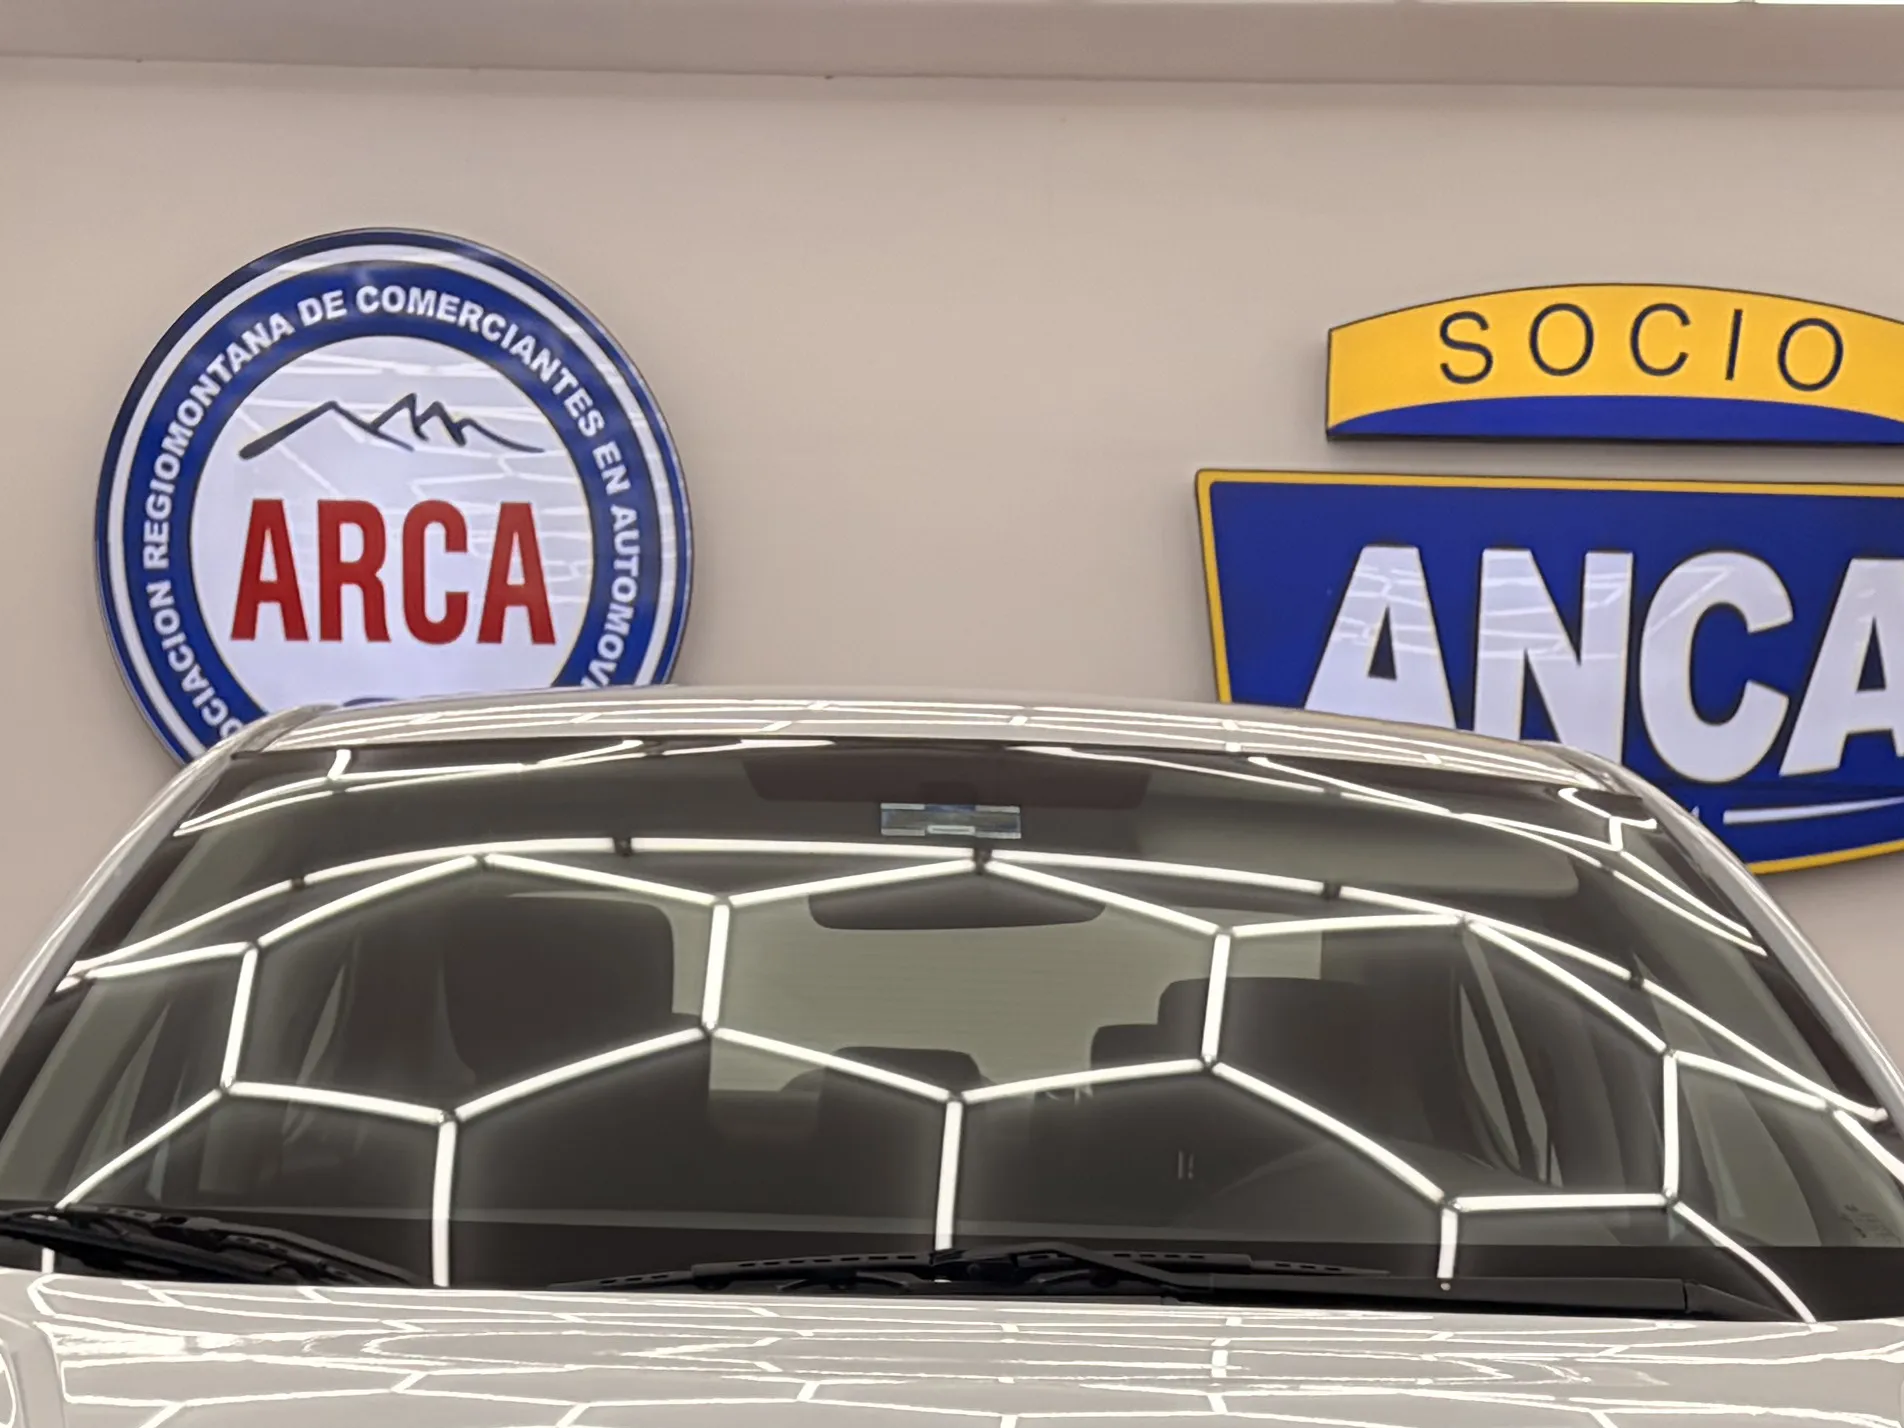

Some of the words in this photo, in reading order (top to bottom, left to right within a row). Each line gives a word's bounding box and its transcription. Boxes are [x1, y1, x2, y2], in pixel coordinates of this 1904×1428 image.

[1438, 303, 1844, 391] SOCIO
[143, 313, 295, 569] REGIOMONTANA
[298, 290, 348, 327] DE
[356, 285, 605, 437] COMERCIANTES
[593, 439, 630, 495] EN
[230, 498, 556, 645] ARCA
